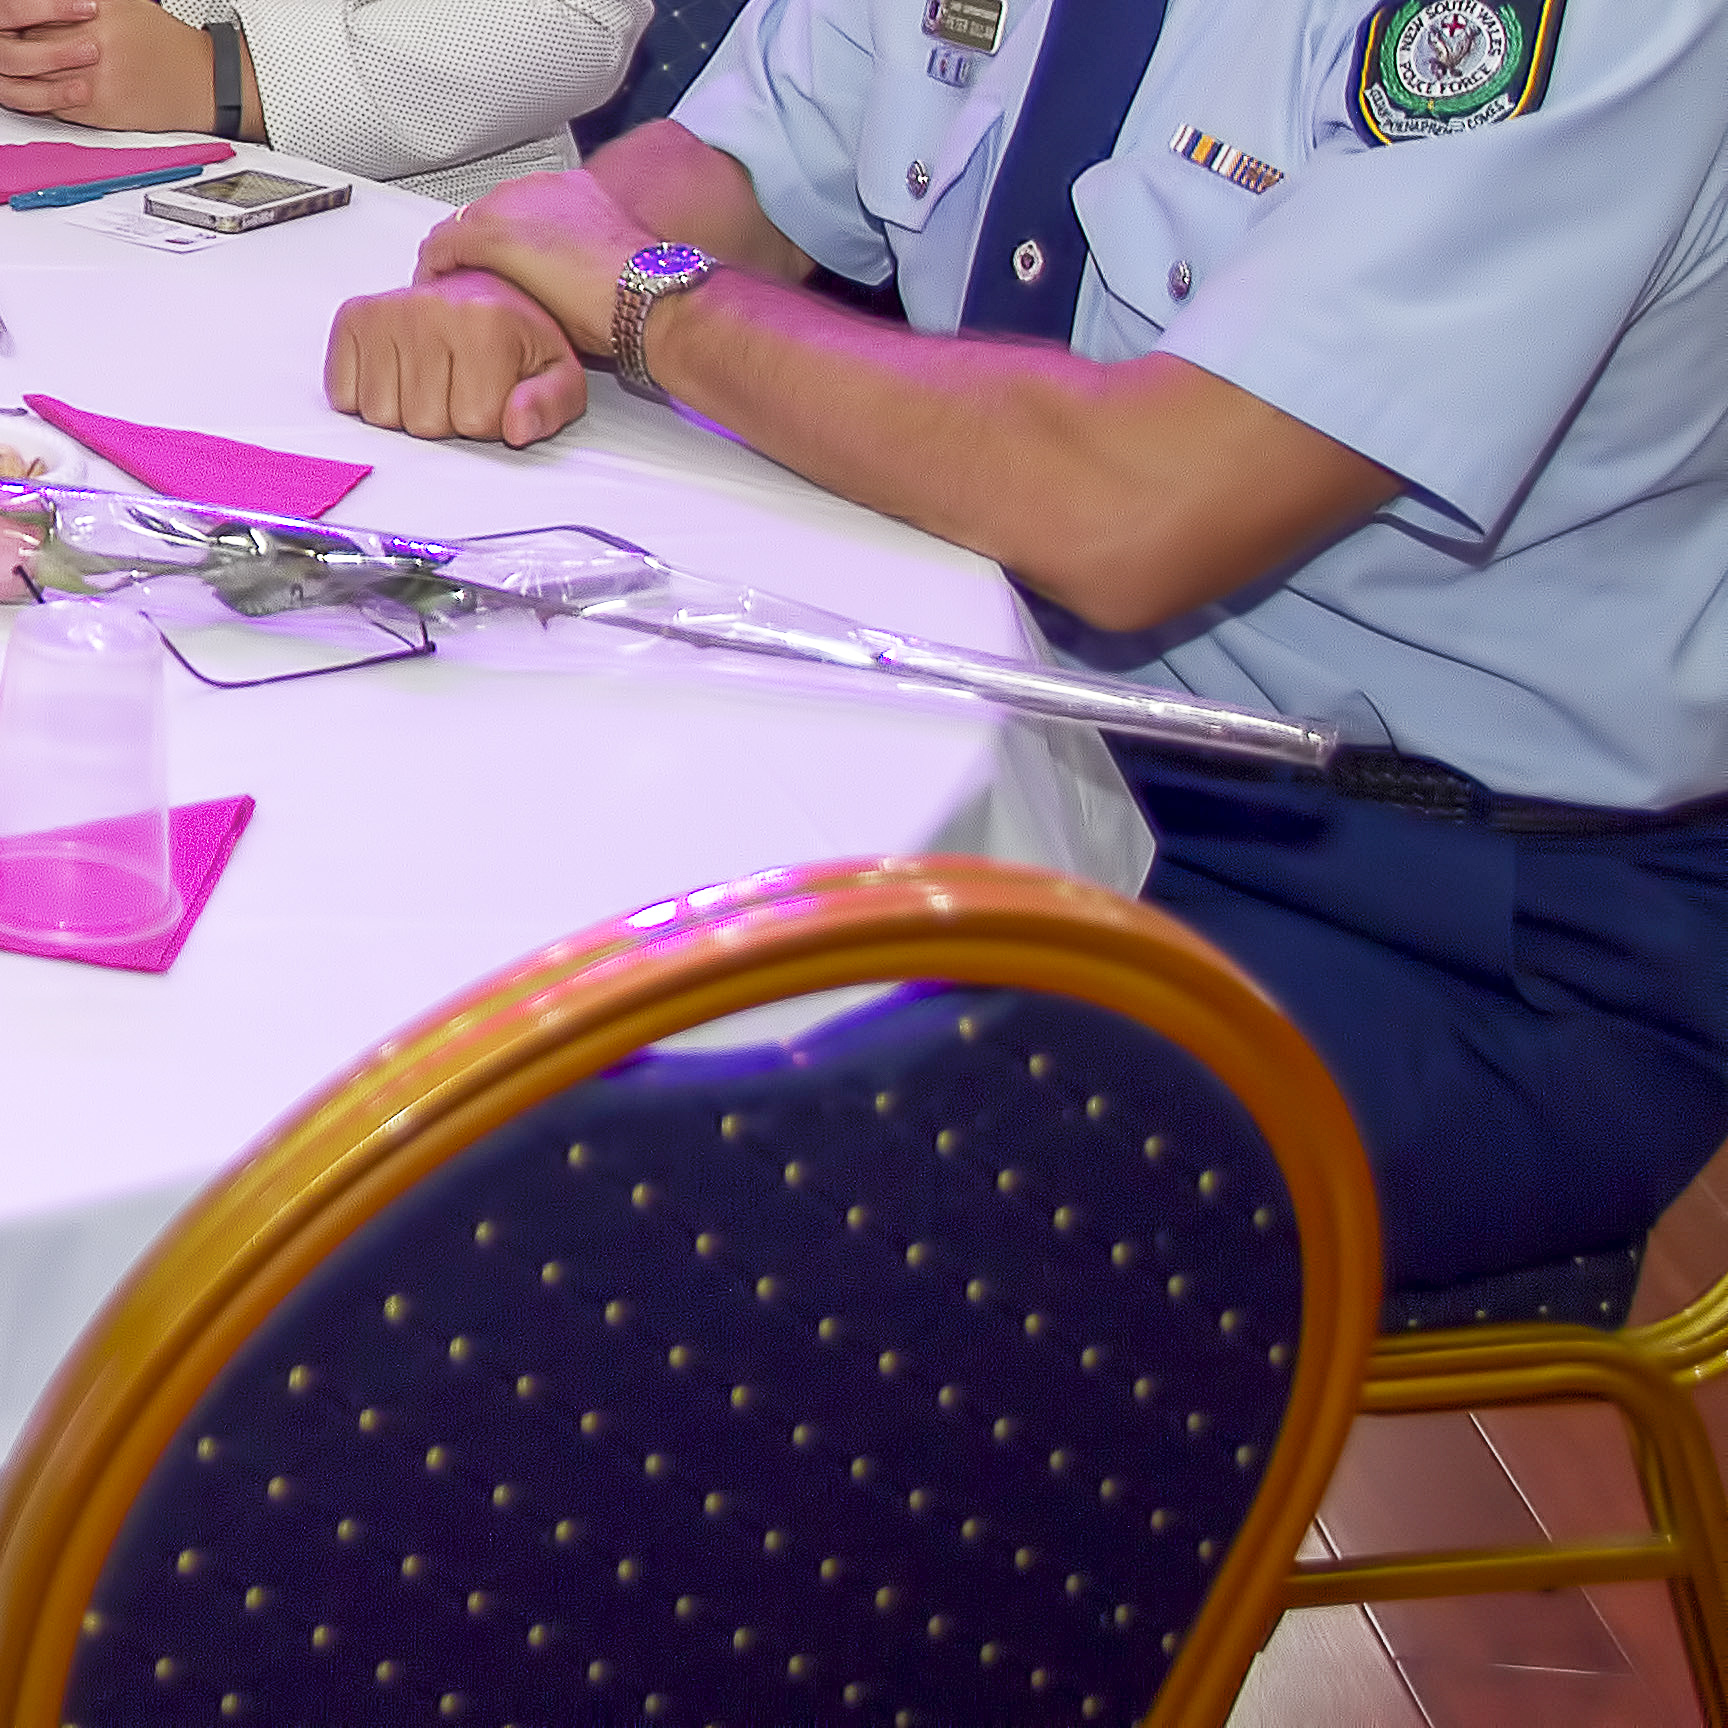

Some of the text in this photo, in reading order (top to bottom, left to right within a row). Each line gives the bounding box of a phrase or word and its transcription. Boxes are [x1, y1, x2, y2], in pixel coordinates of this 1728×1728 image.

[1426, 0, 1477, 20] SOUTH
[1476, 8, 1503, 56] WALES
[1440, 63, 1490, 94] FORCE
